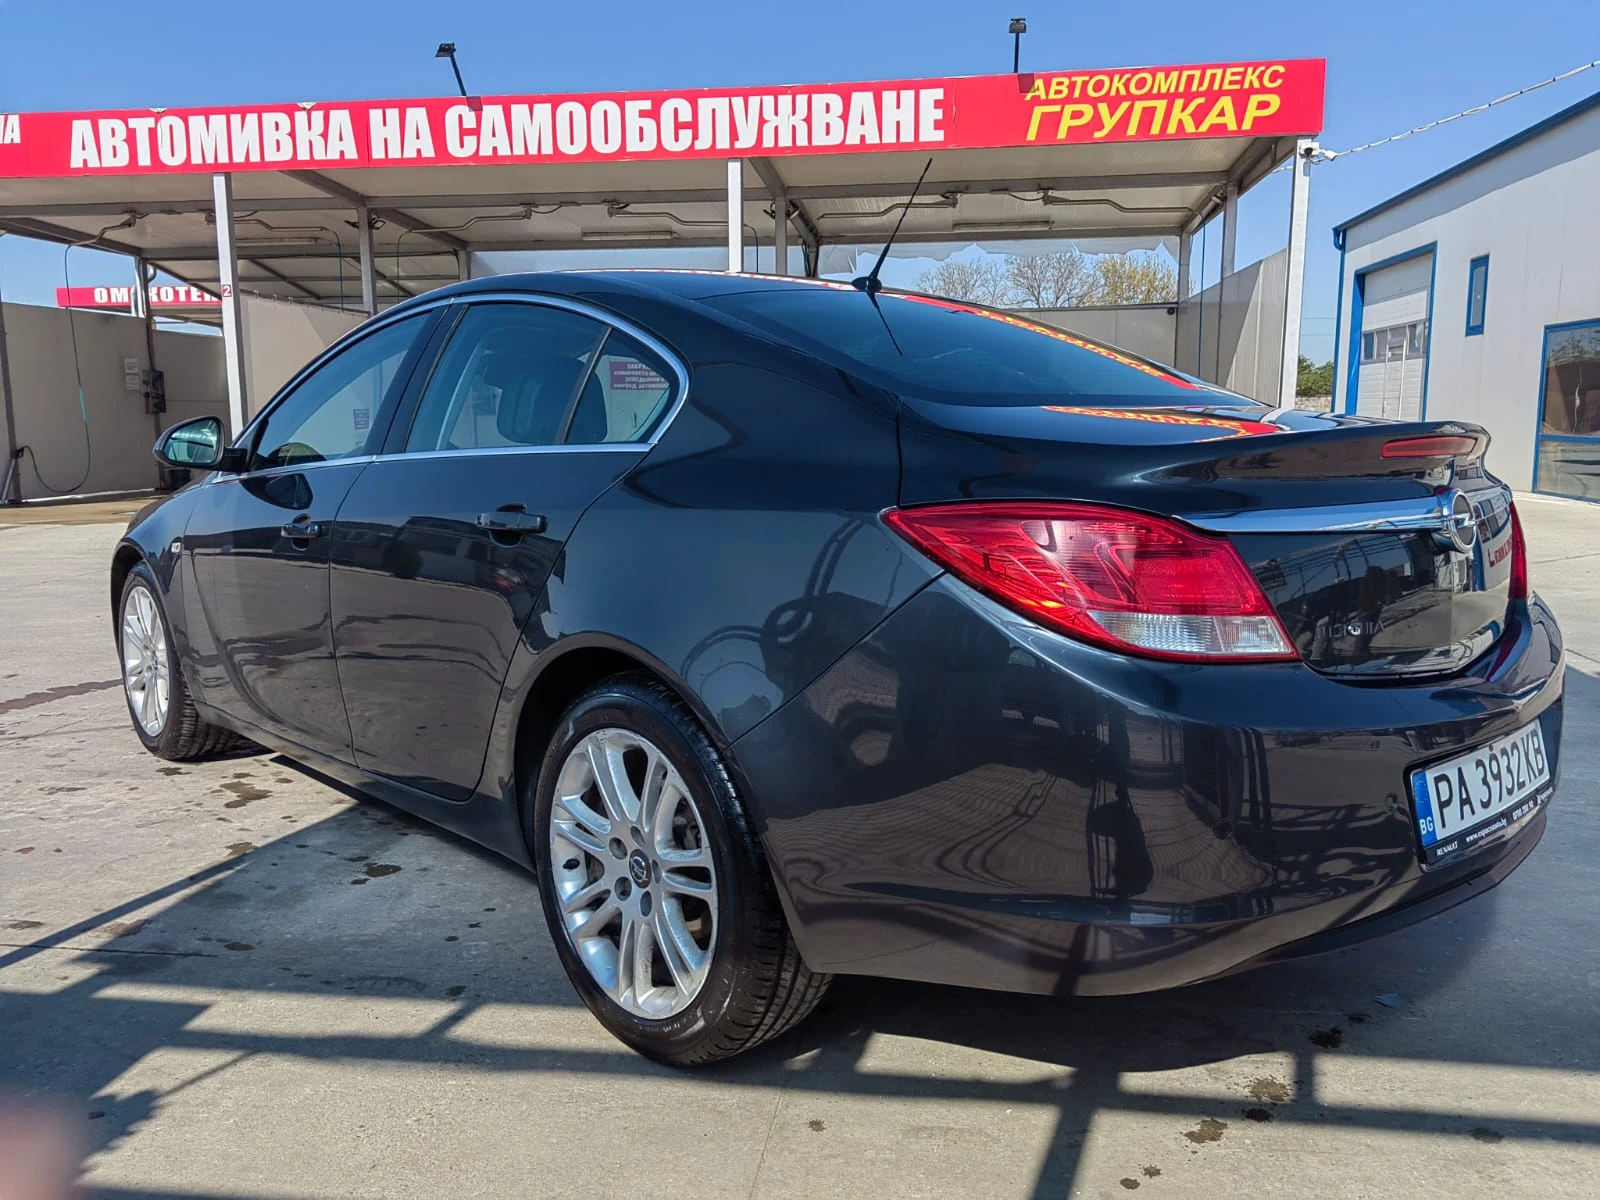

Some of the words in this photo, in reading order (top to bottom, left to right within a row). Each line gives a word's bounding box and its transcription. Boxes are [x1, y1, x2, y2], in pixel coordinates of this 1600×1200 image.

[1025, 65, 1285, 101] АВТОКОМПЛЕКС
[70, 109, 358, 168] АВТОМИВКА
[369, 105, 435, 160] НА
[444, 88, 945, 158] САМООБСЛУЖВАНЕ
[1026, 94, 1281, 141] ГРУПКАР
[223, 286, 231, 297] 2
[1419, 816, 1434, 835] BG
[1436, 840, 1459, 856] RENAULT
